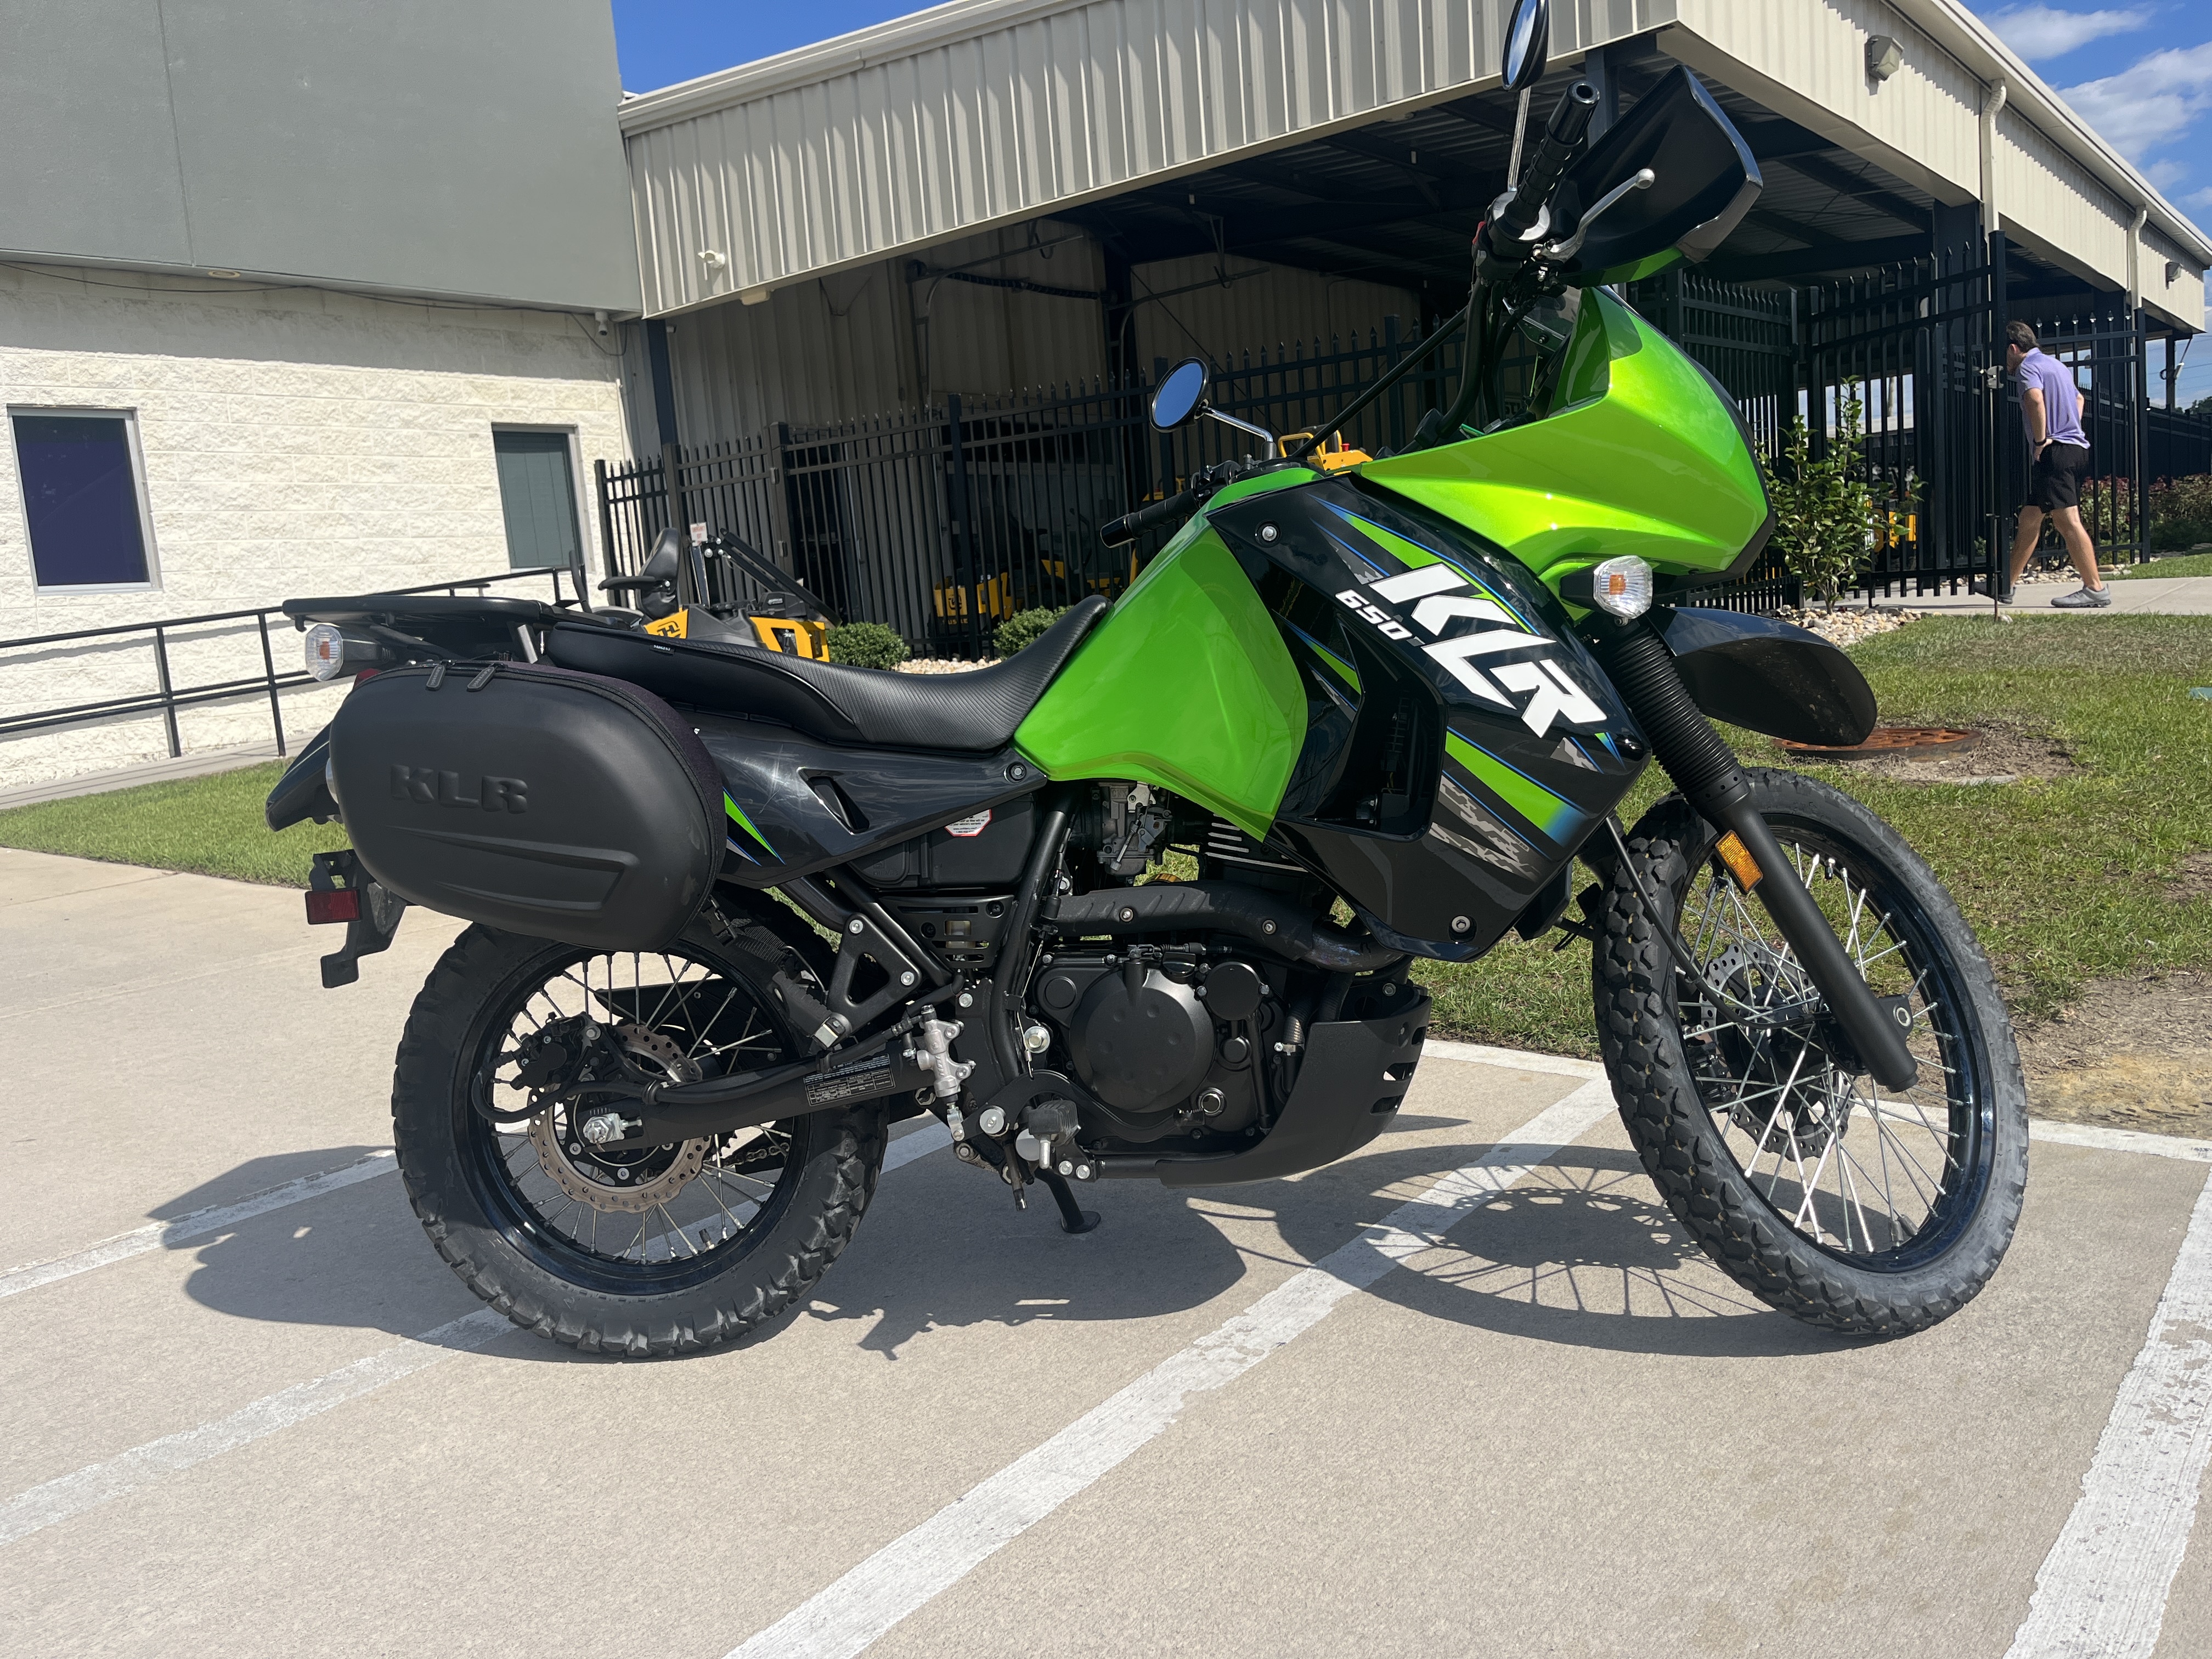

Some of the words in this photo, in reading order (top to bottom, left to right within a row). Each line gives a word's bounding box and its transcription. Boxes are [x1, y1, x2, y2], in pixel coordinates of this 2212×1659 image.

[1335, 589, 1413, 641] 650
[1369, 561, 1607, 738] KLR
[390, 764, 528, 815] KLR
